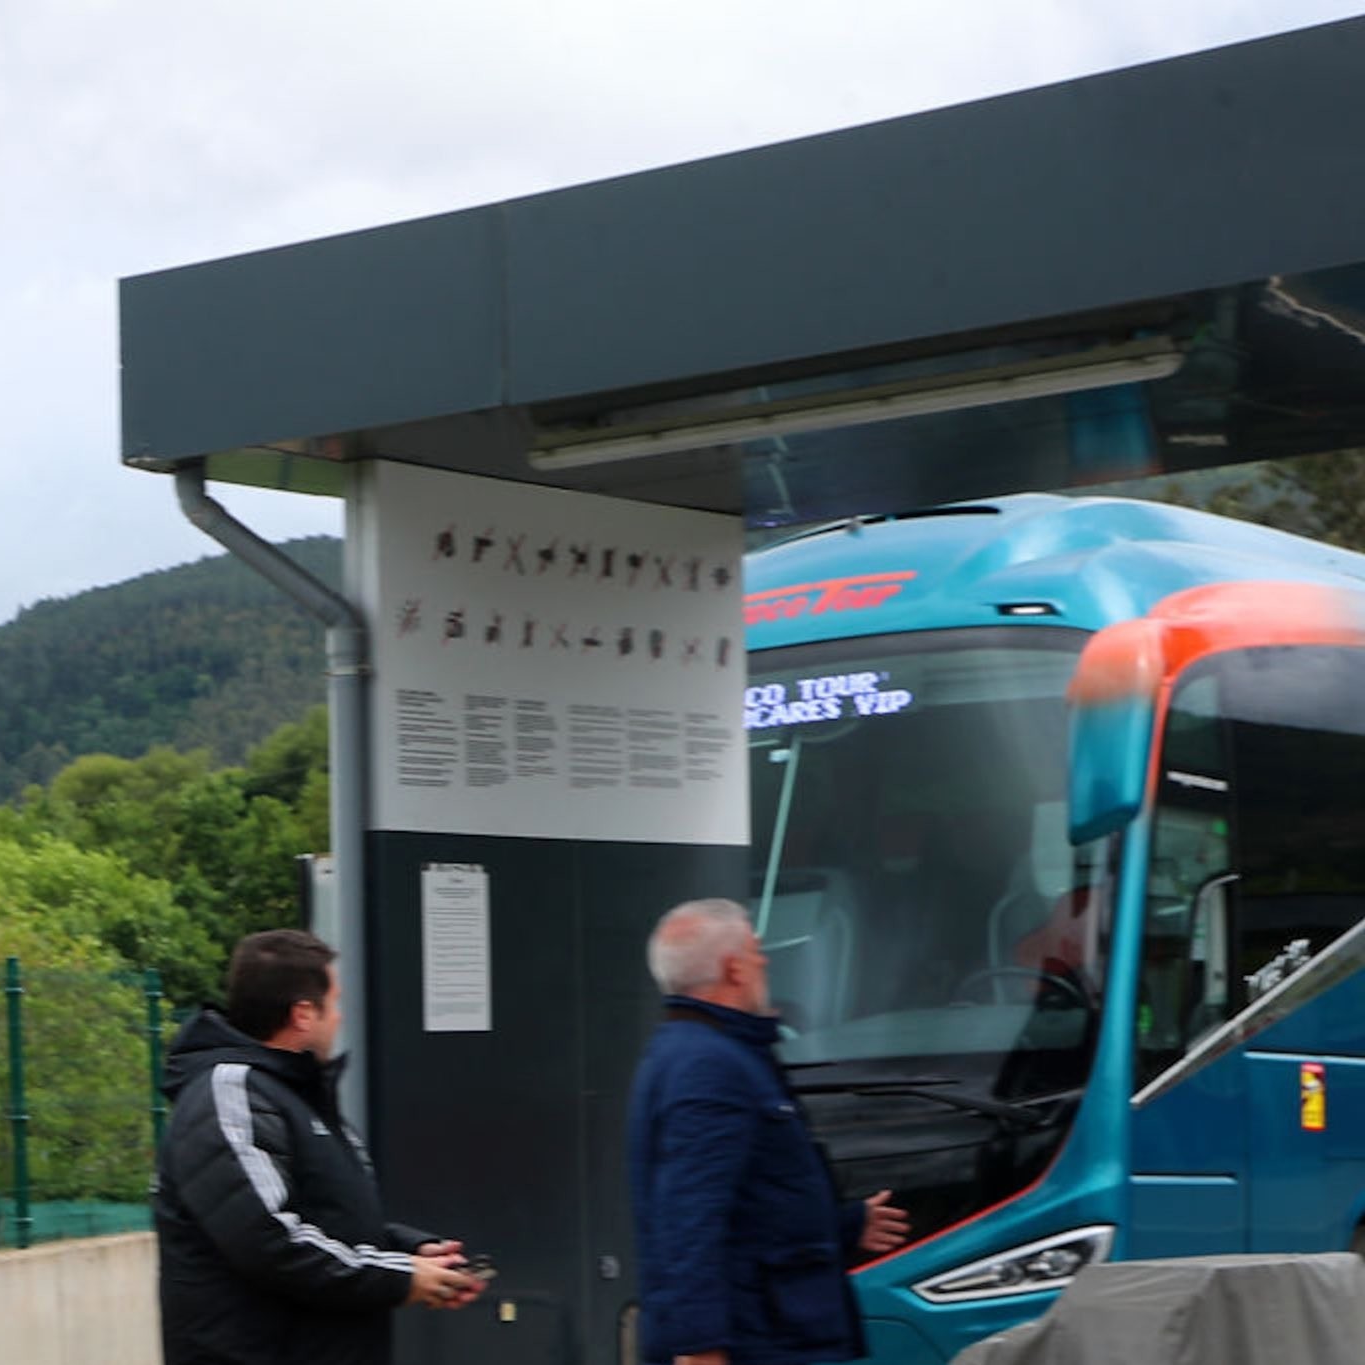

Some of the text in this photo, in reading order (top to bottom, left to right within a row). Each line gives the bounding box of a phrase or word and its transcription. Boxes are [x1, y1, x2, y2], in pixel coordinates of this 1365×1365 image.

[744, 672, 880, 708] CO TOUR
[853, 689, 913, 716] VIP
